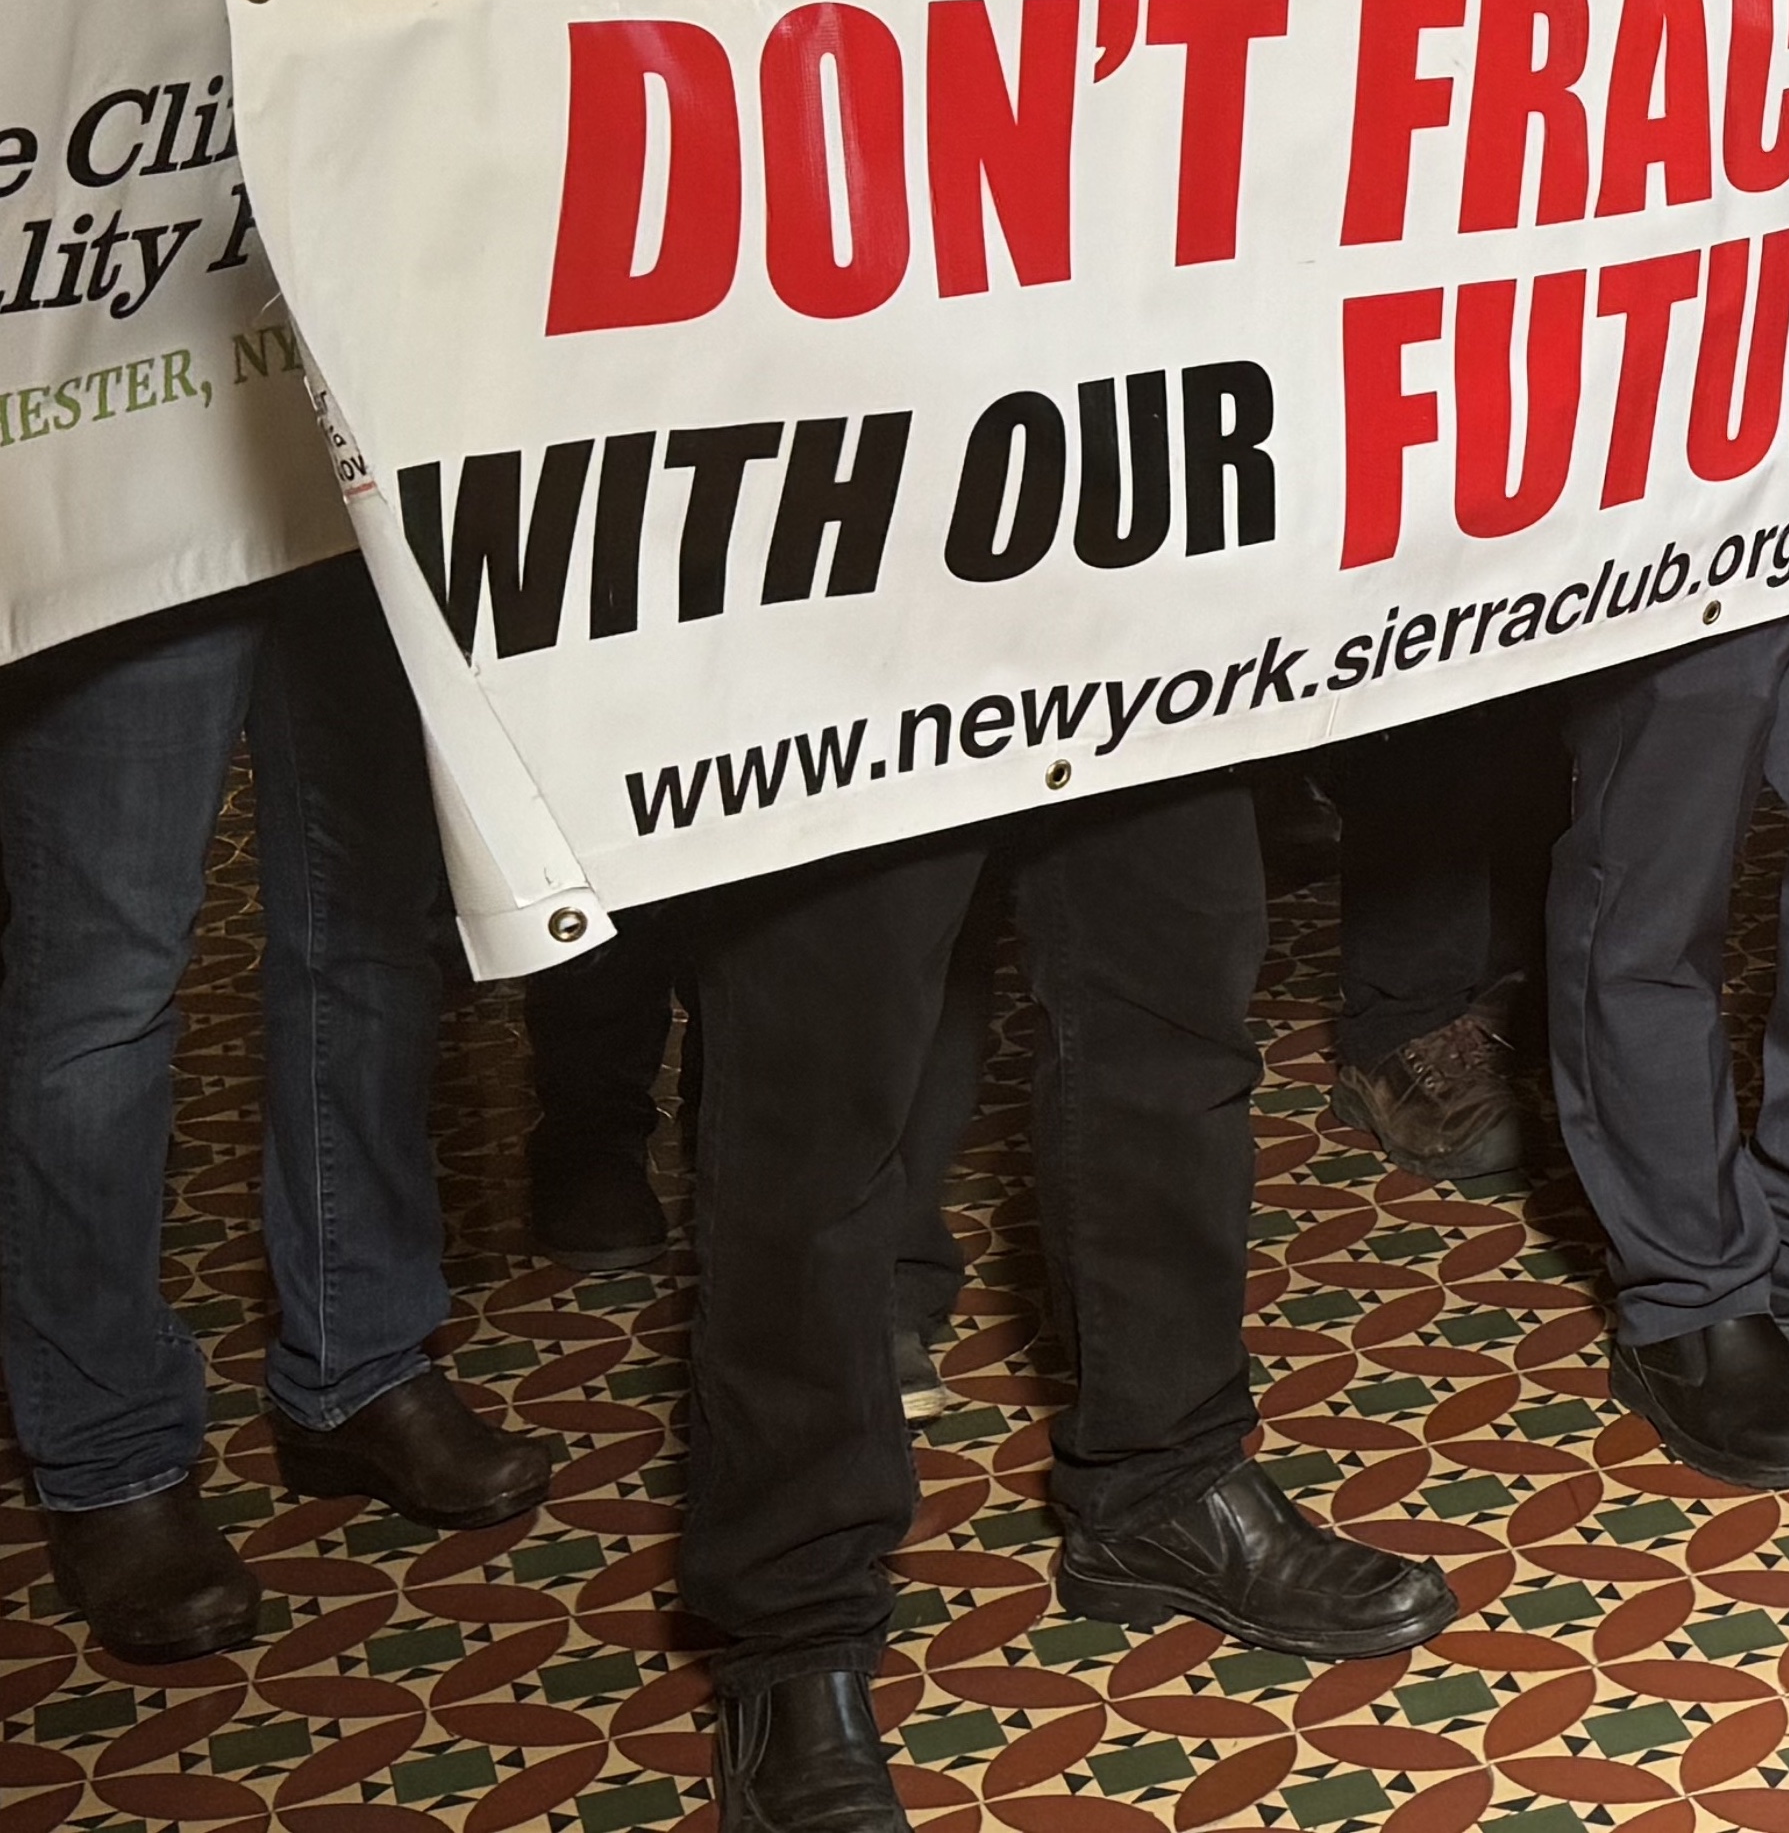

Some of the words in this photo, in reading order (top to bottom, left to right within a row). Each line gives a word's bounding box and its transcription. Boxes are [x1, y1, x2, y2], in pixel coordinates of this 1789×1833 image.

[0, 209, 202, 319] lity
[399, 411, 914, 672] WITH
[944, 361, 1280, 582] OUR
